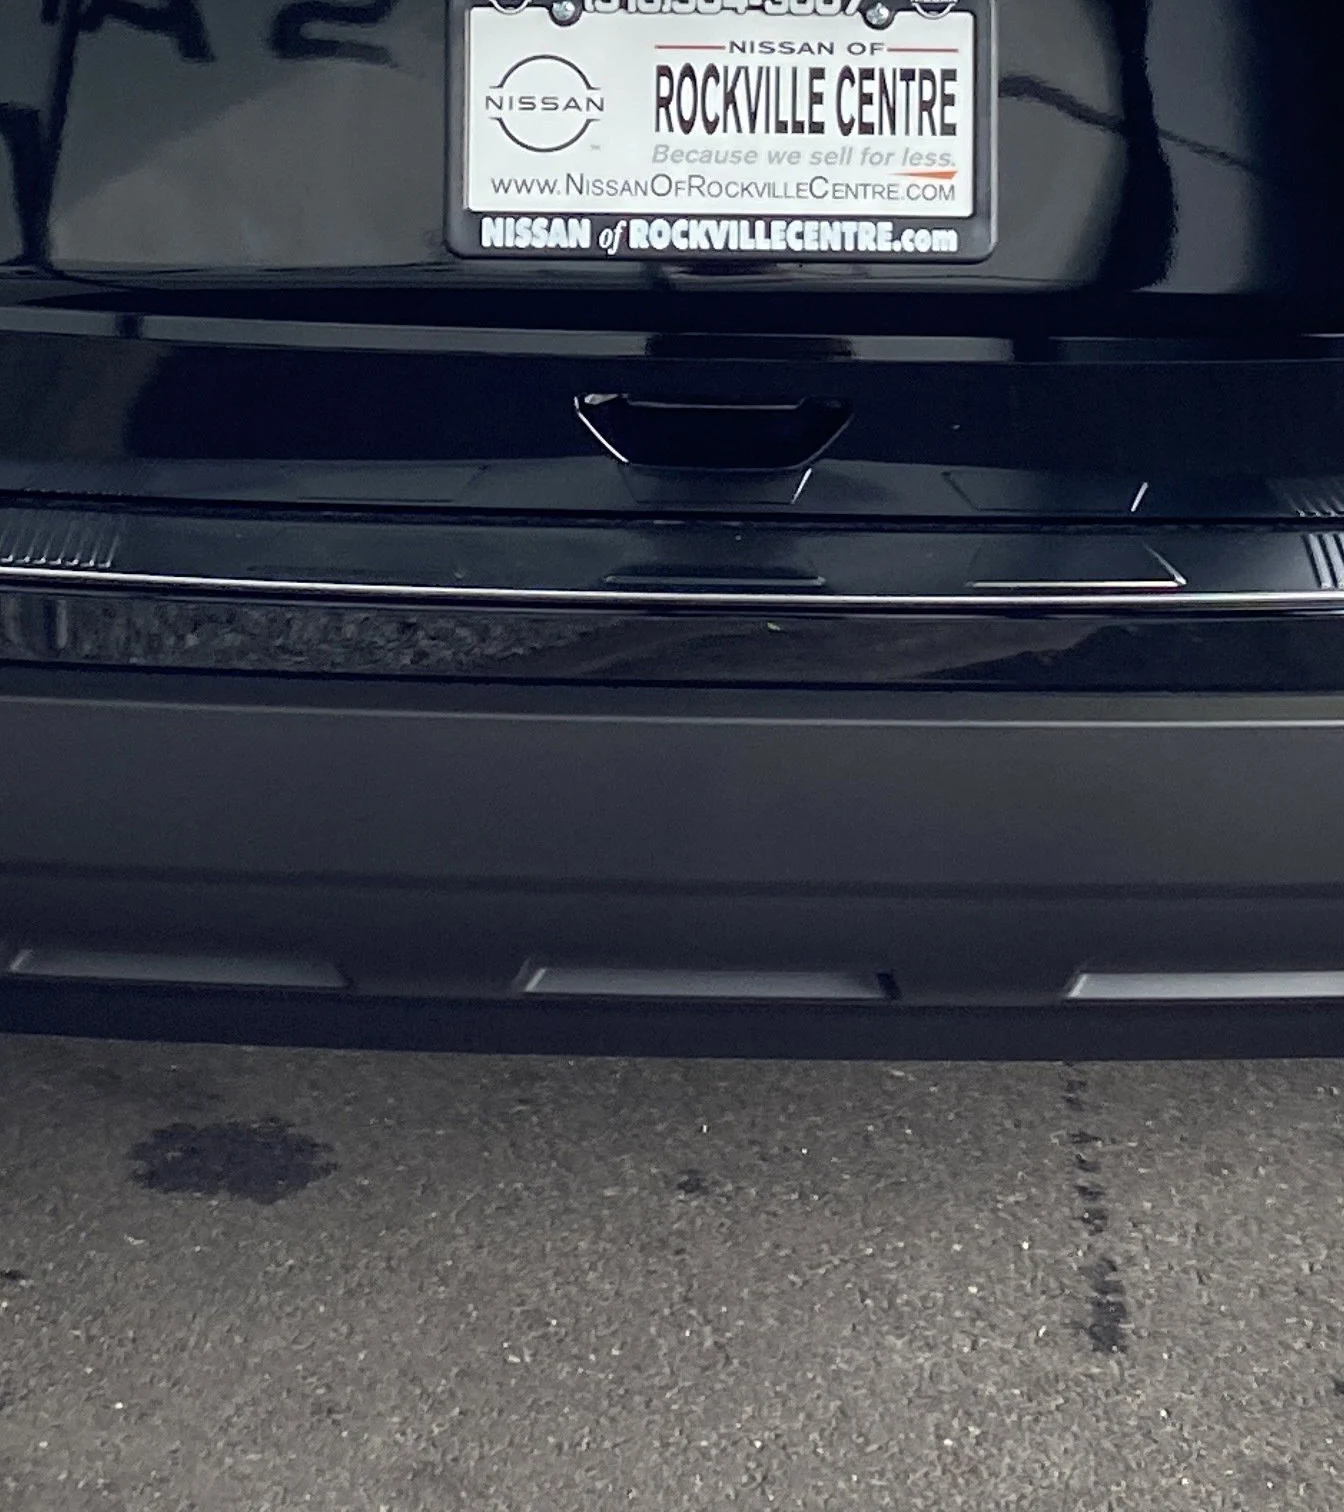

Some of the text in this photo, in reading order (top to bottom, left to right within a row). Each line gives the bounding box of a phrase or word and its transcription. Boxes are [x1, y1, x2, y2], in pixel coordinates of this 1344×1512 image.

[729, 41, 885, 55] NISSAN OF
[485, 96, 604, 112] NISSAN
[655, 63, 957, 136] ROCKVILLE CENTRE
[652, 144, 956, 167] Because we sell for less.
[481, 217, 958, 255] NISSAN of ROCKVILLECENTRE.com
